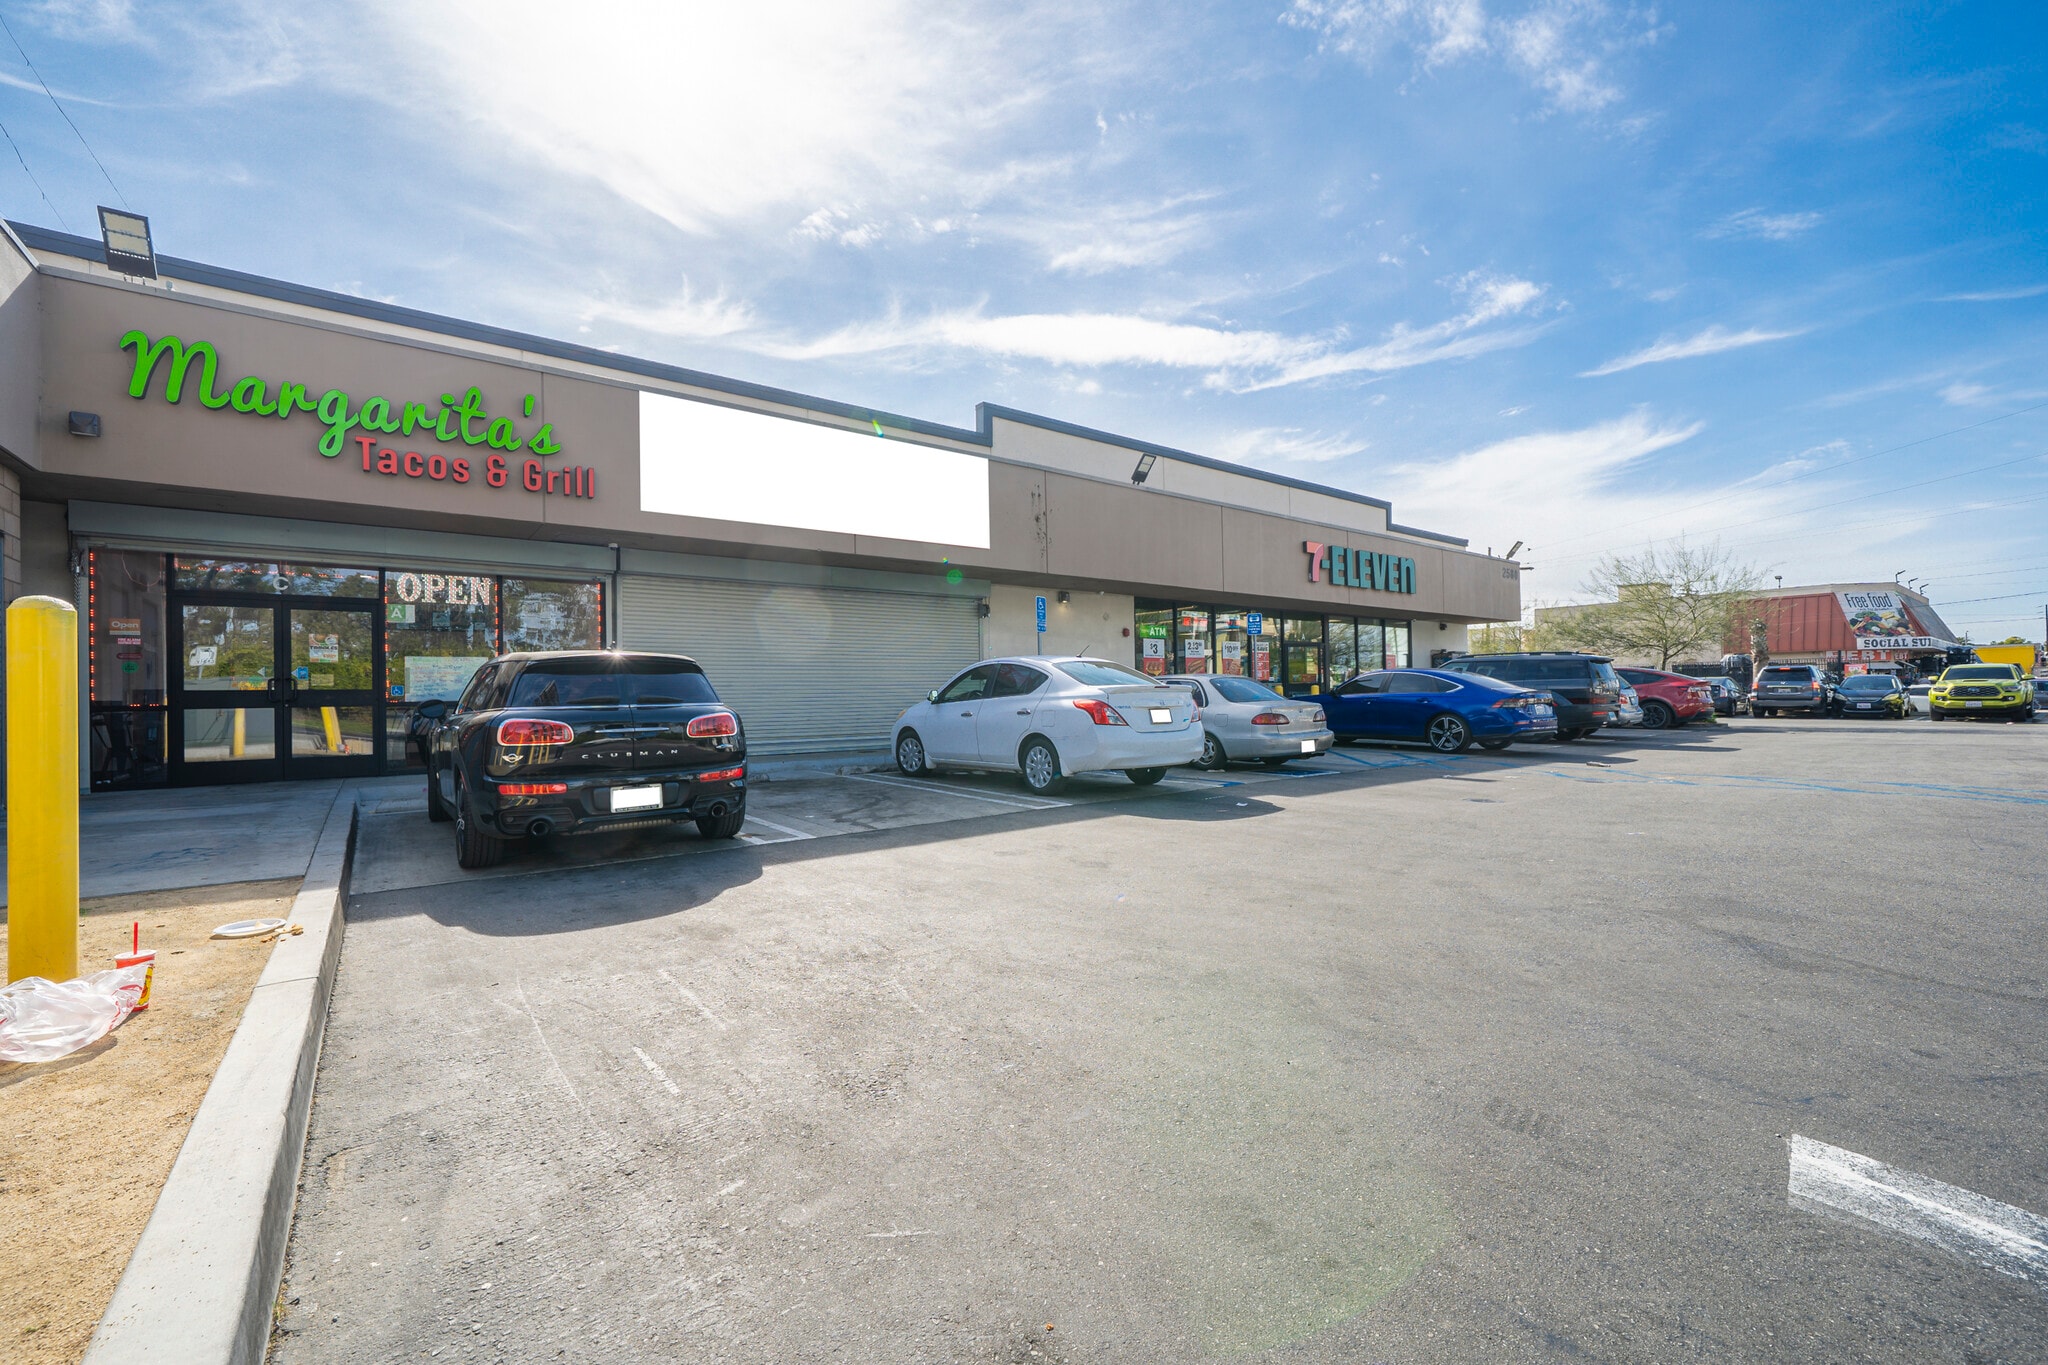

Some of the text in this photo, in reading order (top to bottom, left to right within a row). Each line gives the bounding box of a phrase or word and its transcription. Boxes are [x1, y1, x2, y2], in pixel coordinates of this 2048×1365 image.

[119, 330, 562, 458] Margarita's
[355, 436, 596, 499] Tacos & Grill
[396, 572, 491, 606] OPEN
[1844, 592, 1893, 608] Free food
[391, 608, 403, 618] A
[111, 621, 139, 630] Open
[1150, 627, 1167, 637] ATM
[1863, 638, 1909, 648] SOCIAL
[1150, 643, 1158, 654] $3
[581, 749, 678, 759] CLUBMAN
